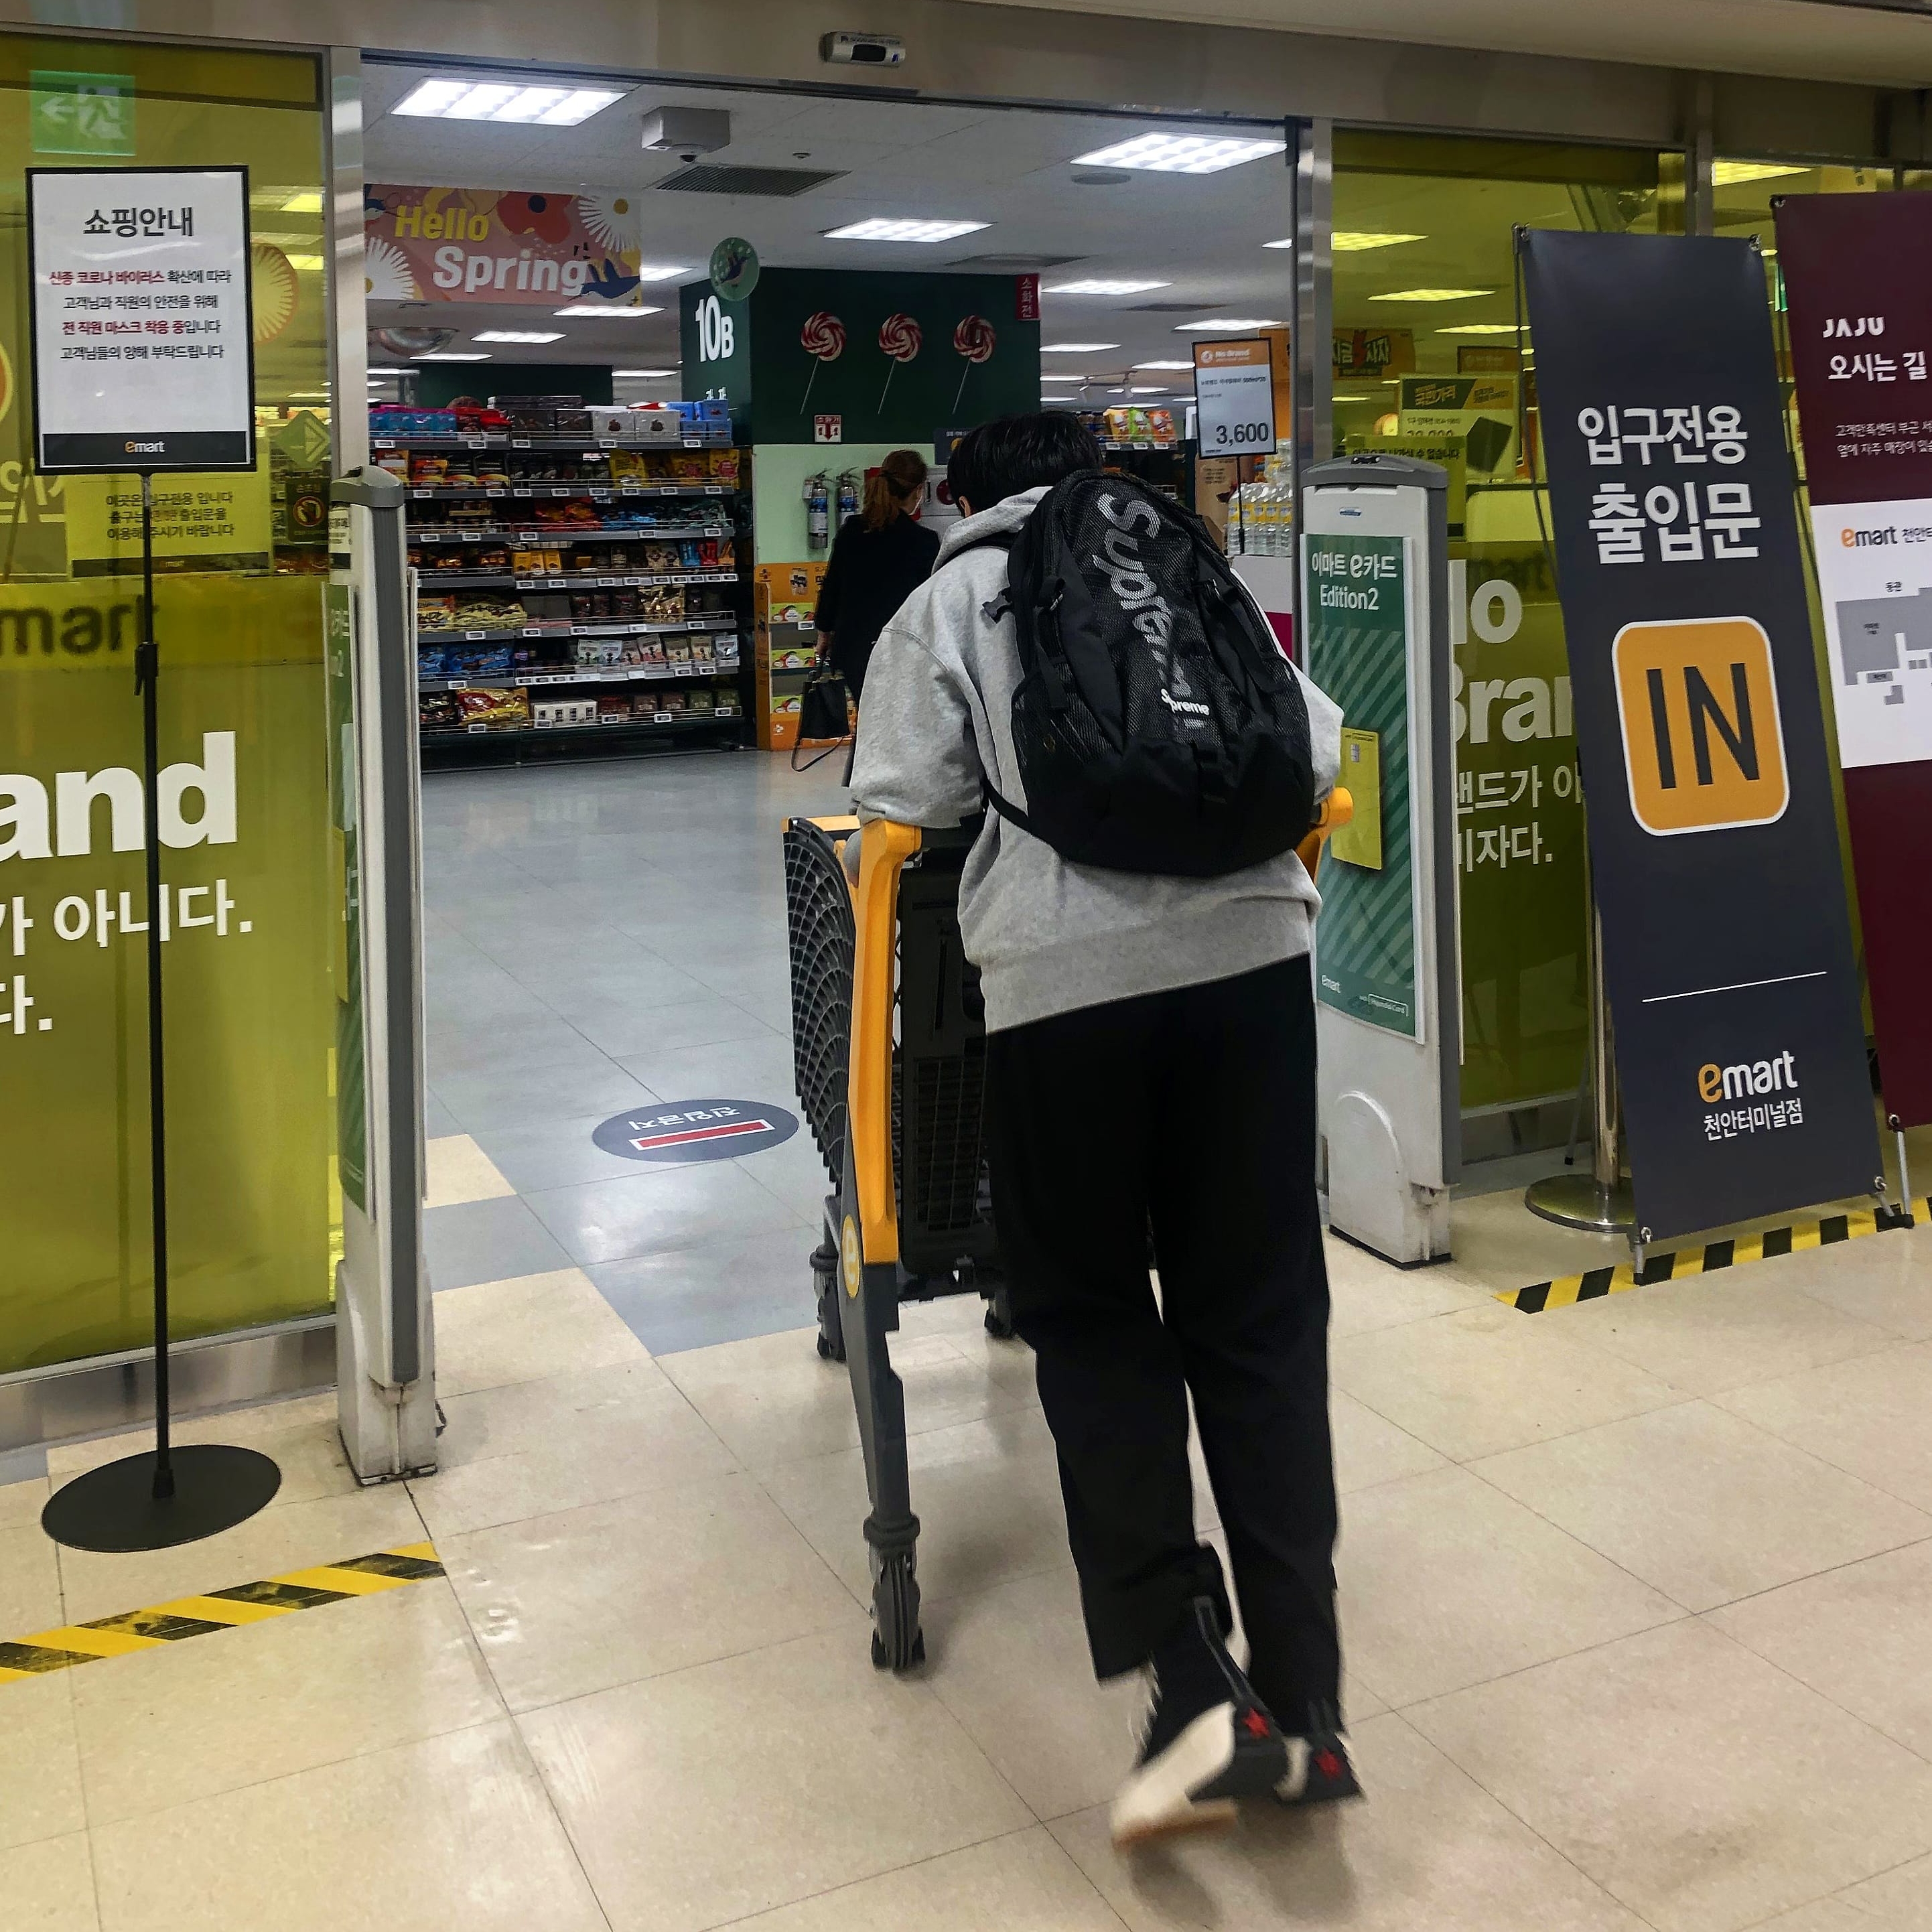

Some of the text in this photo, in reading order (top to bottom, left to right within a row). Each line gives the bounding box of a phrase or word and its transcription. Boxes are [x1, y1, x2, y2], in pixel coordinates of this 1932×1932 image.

[83, 206, 194, 238] 쇼핑안내
[395, 204, 490, 241] Hello
[49, 269, 232, 286] 신종 코로나 바이러스 확산에 따라
[433, 245, 589, 296] Spring
[63, 294, 219, 311] 고객님과 직원의 안전을 위해
[1020, 276, 1034, 318] 소화전
[62, 319, 222, 336] 전 직원 마스크 착용 중입니다
[1821, 316, 1886, 338] JAJU
[60, 344, 225, 360] 고객님들의 양해 부탁드립니다
[1827, 350, 1927, 382] 오시는 길
[1216, 421, 1269, 446] 3,600
[1577, 403, 1748, 466] 입구전용
[1898, 421, 1920, 435] 부근
[124, 439, 165, 454] emart
[1837, 443, 1859, 458] 옆에
[1860, 441, 1883, 456] 자주
[1884, 440, 1917, 455] 매장이
[196, 491, 234, 505] 입니다
[186, 523, 234, 538] 바랍니다
[1588, 481, 1762, 565] 출입문
[1841, 526, 1898, 548] emart
[1312, 551, 1397, 581] 이마트 e카드
[1091, 492, 1192, 697] Supre
[1320, 583, 1380, 611] Edition2
[1647, 662, 1761, 790] IN
[53, 879, 254, 949] 아니다.
[1697, 1049, 1799, 1104] emart
[628, 1105, 741, 1131] 진입금지
[1704, 1097, 1805, 1143] 천안터미널점
